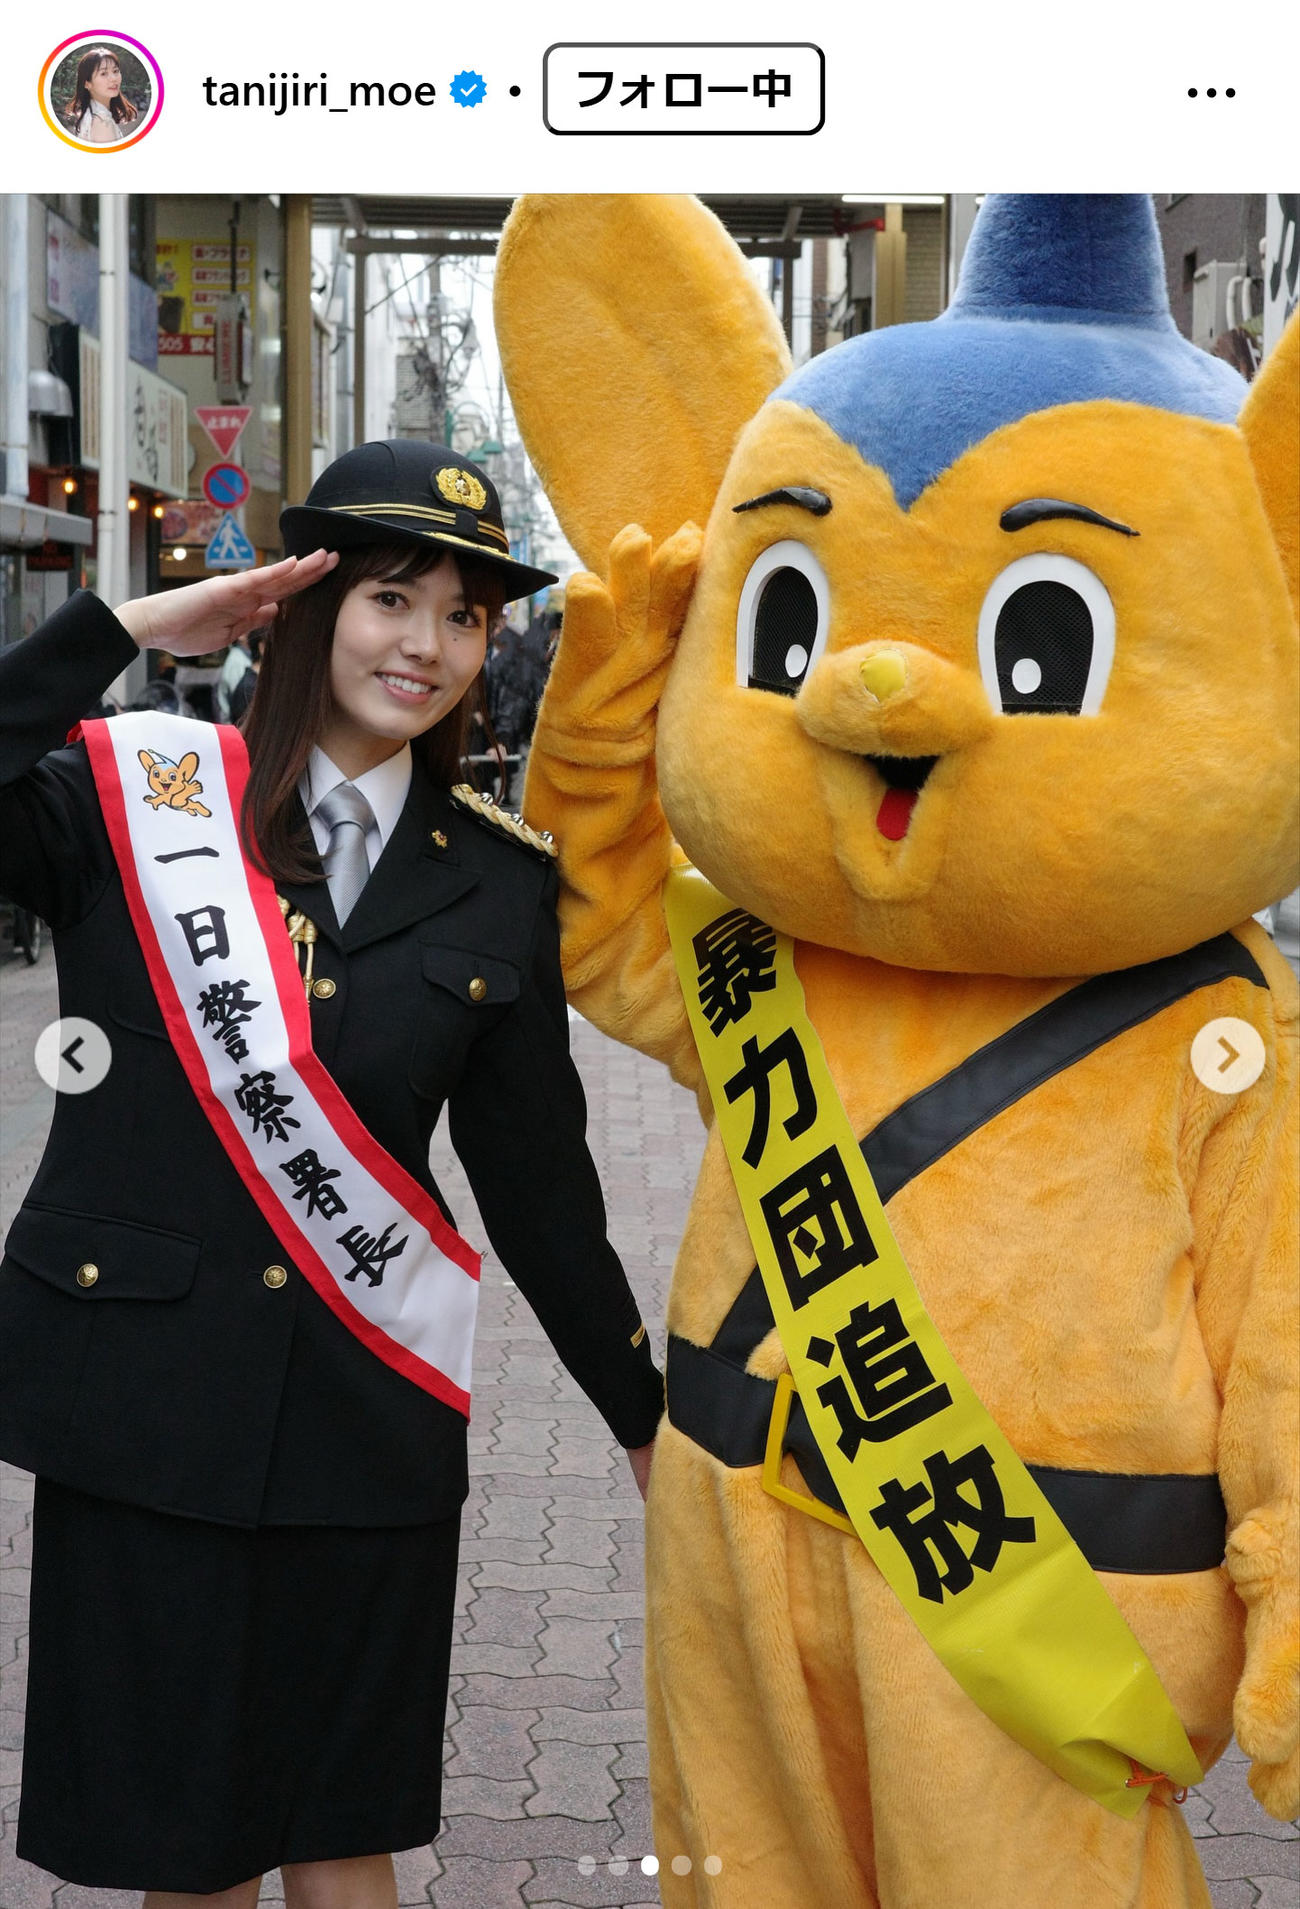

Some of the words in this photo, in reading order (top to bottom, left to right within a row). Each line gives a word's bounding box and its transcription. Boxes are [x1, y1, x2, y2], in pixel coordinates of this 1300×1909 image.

[154, 847, 410, 1287] 一日警察署長
[692, 907, 1037, 1604] 暴力団追放
